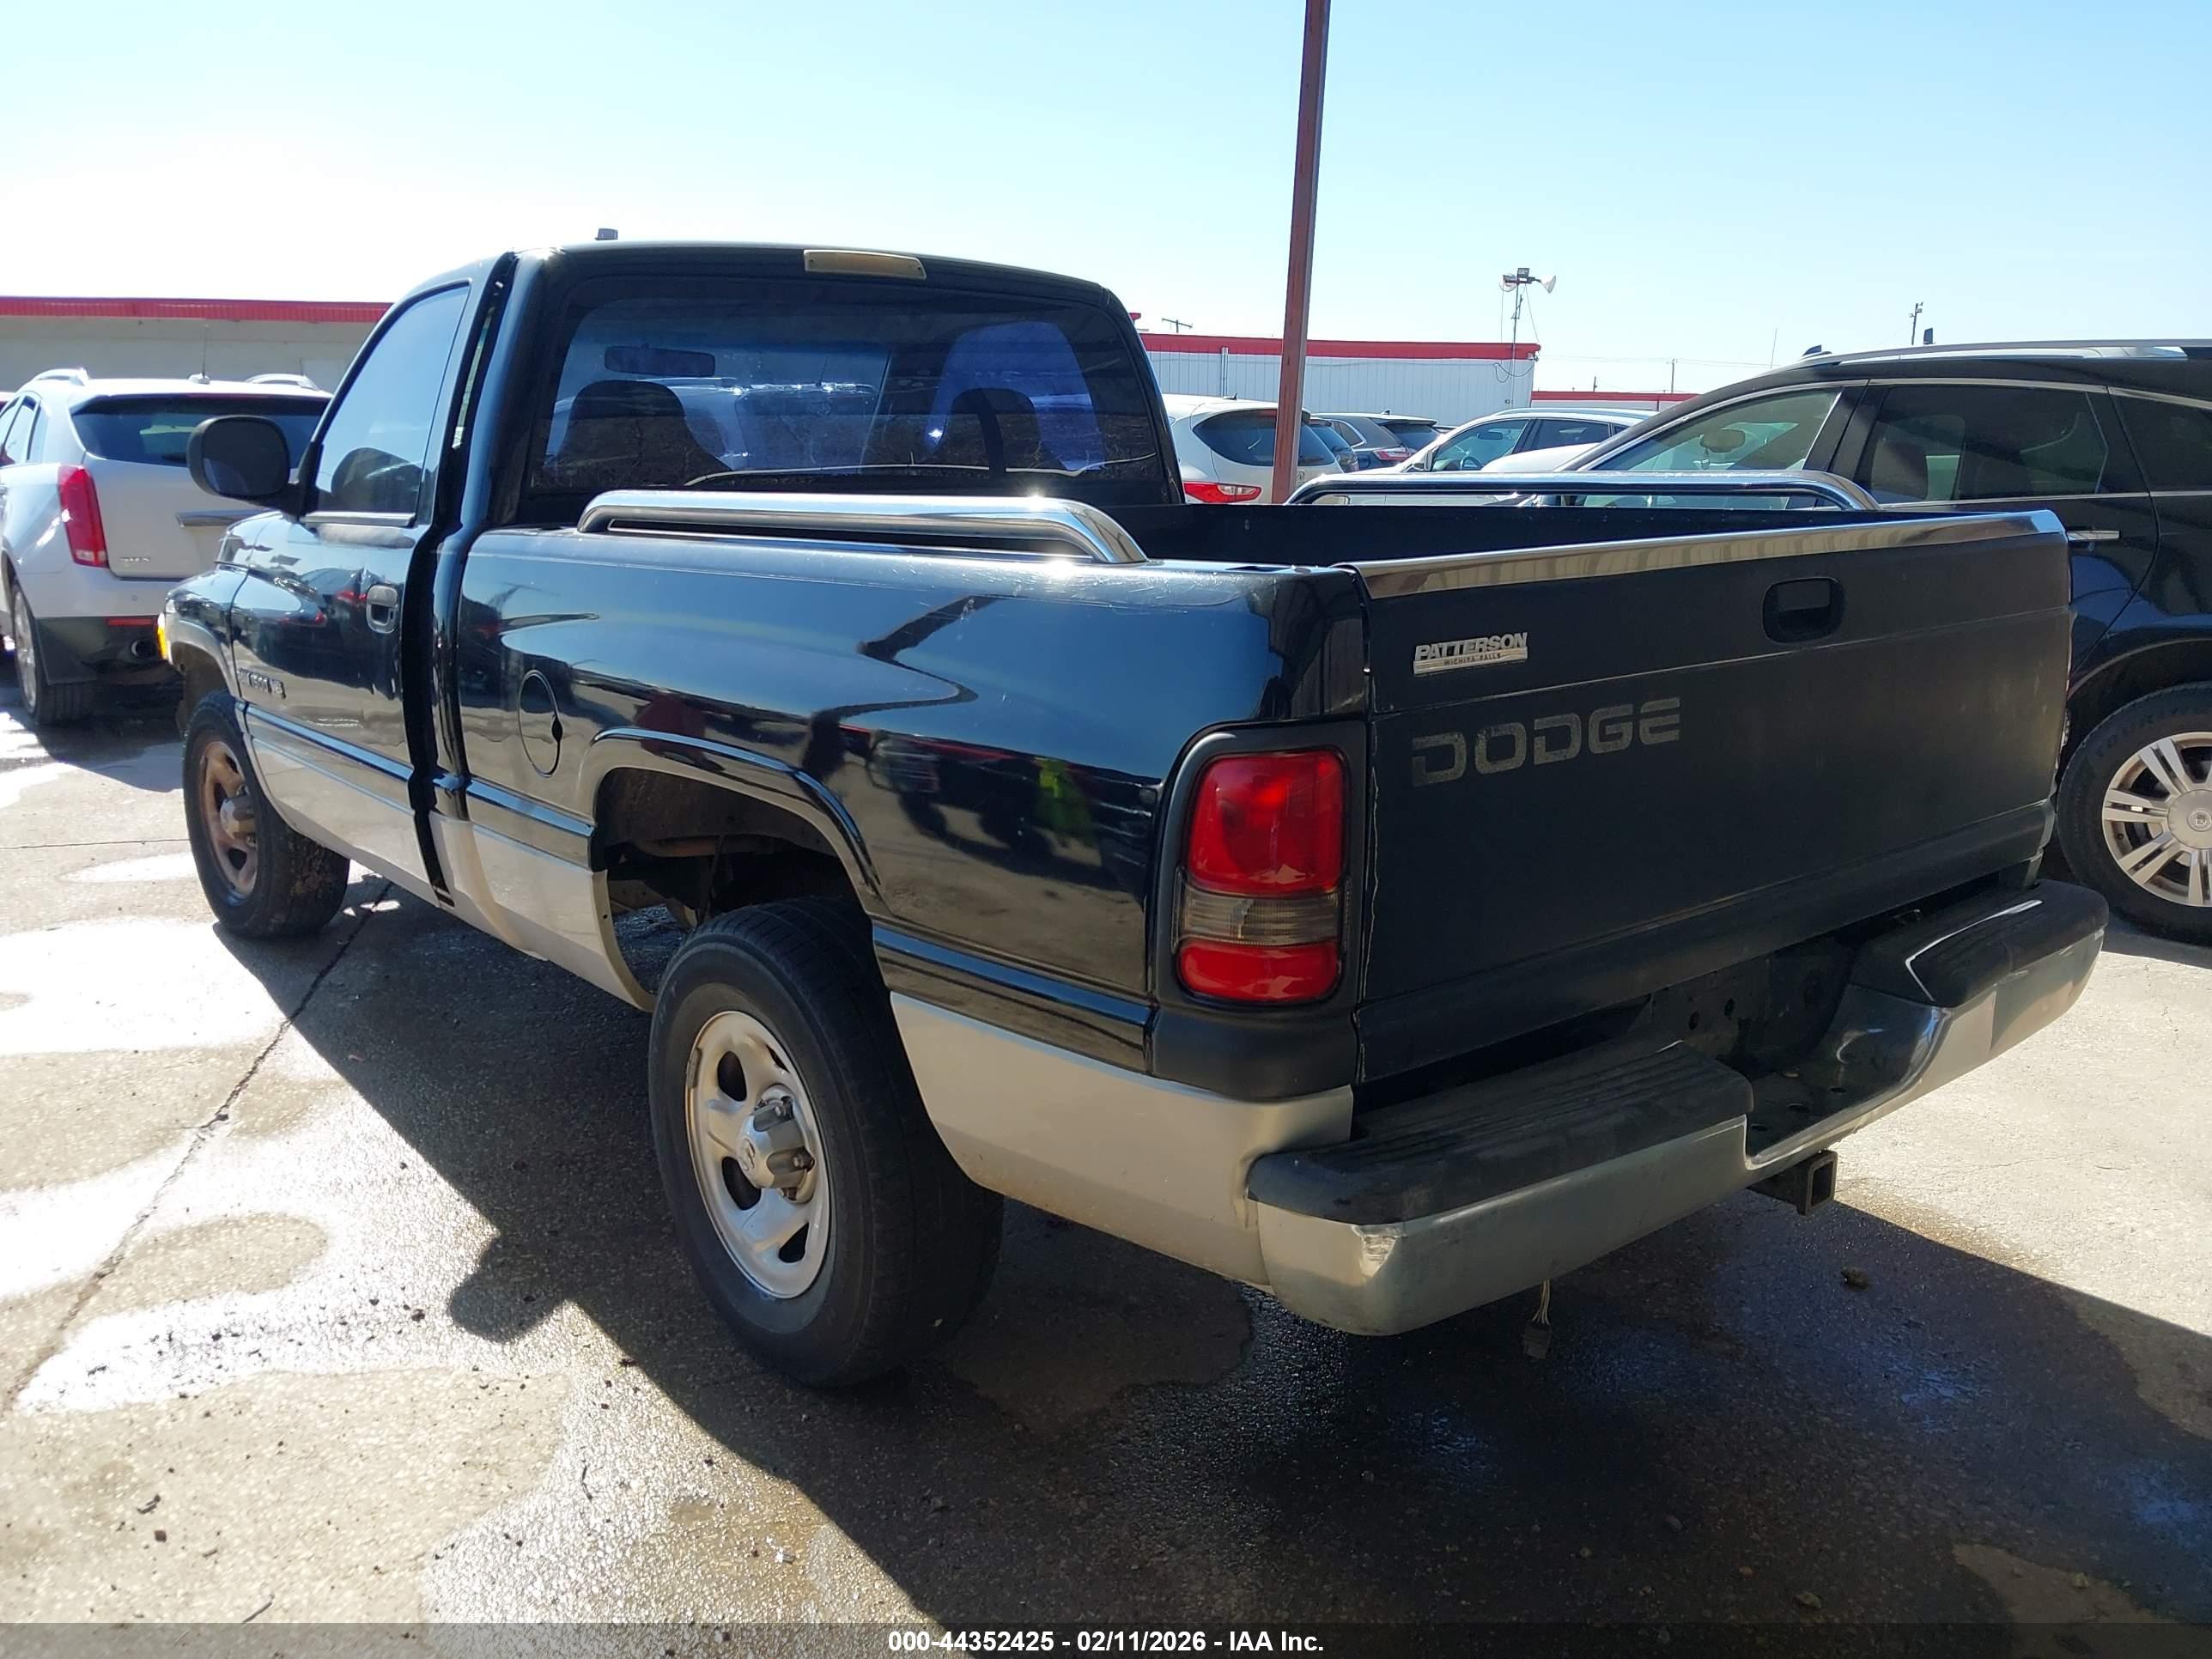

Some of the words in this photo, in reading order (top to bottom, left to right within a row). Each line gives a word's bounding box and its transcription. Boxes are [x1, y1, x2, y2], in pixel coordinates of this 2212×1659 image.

[1414, 632, 1528, 661] PATTERSON
[1443, 656, 1475, 665] WICHITA
[1479, 653, 1501, 661] FALLS
[1413, 697, 1680, 787] DODGE
